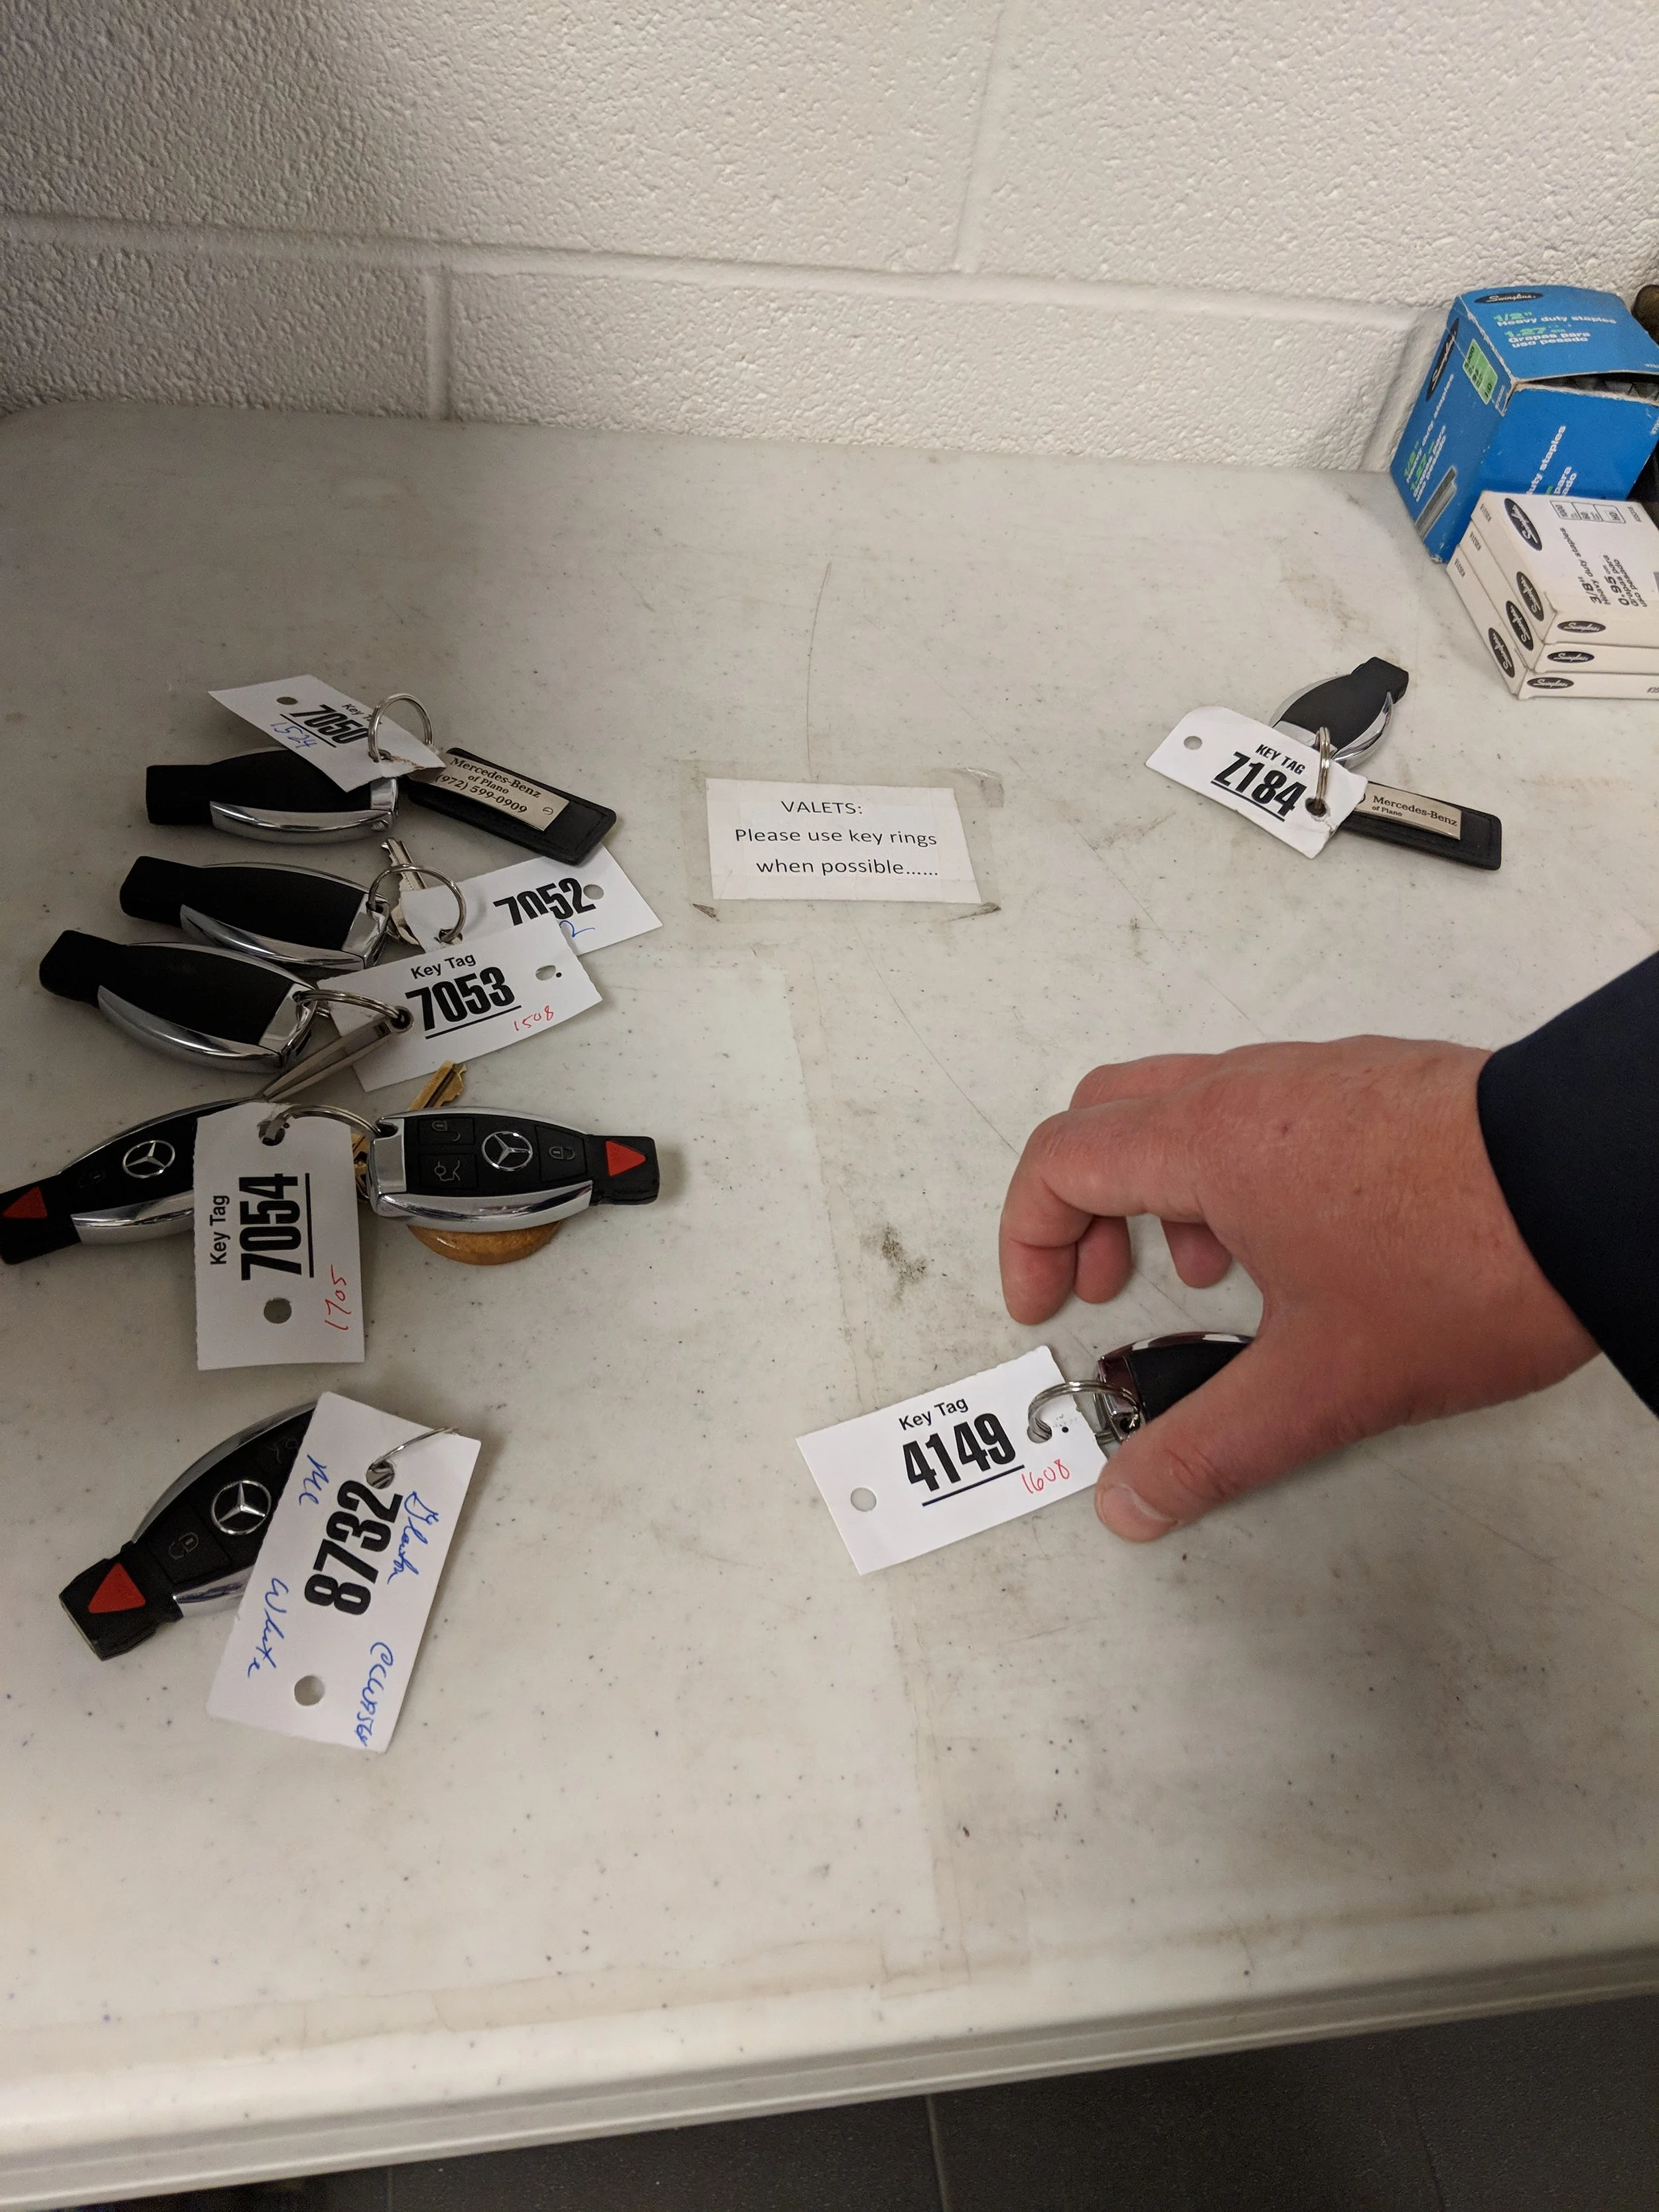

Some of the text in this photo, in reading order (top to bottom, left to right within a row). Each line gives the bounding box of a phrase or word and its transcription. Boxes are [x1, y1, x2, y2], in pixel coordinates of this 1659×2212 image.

[1497, 317, 1537, 327] Heavy
[1571, 315, 1617, 324] staples
[1539, 425, 1566, 471] staples
[1553, 467, 1572, 494] para
[1559, 528, 1581, 557] staples
[1579, 559, 1593, 577] duty
[1603, 555, 1638, 607] Grapas para
[1614, 559, 1648, 607] uso pesado
[1578, 576, 1602, 605] 3/8"
[1591, 579, 1611, 605] Heavy
[1604, 575, 1630, 606] 0.95
[289, 704, 369, 744] 7050
[342, 703, 364, 715] Key
[1255, 744, 1306, 775] KEY TAG
[451, 757, 542, 798] Mercedes-Benz
[479, 778, 509, 794] Plano
[435, 774, 528, 814] (972) 599-0909
[780, 800, 863, 815] VALETS:
[1372, 795, 1458, 827] Mercedes-Benz
[1381, 807, 1403, 817] Plano
[735, 828, 937, 848] Please use key rings
[756, 859, 814, 873] when
[492, 877, 597, 926] 7052
[410, 954, 477, 980] Key Tag
[404, 966, 516, 1031] 7053
[209, 1195, 230, 1266] Key Tag
[239, 1173, 302, 1281] 7054
[899, 1397, 969, 1430] Key Tag
[902, 1413, 1017, 1492] 4149
[1021, 1459, 1070, 1494] 1608
[304, 1479, 403, 1616] 8732
